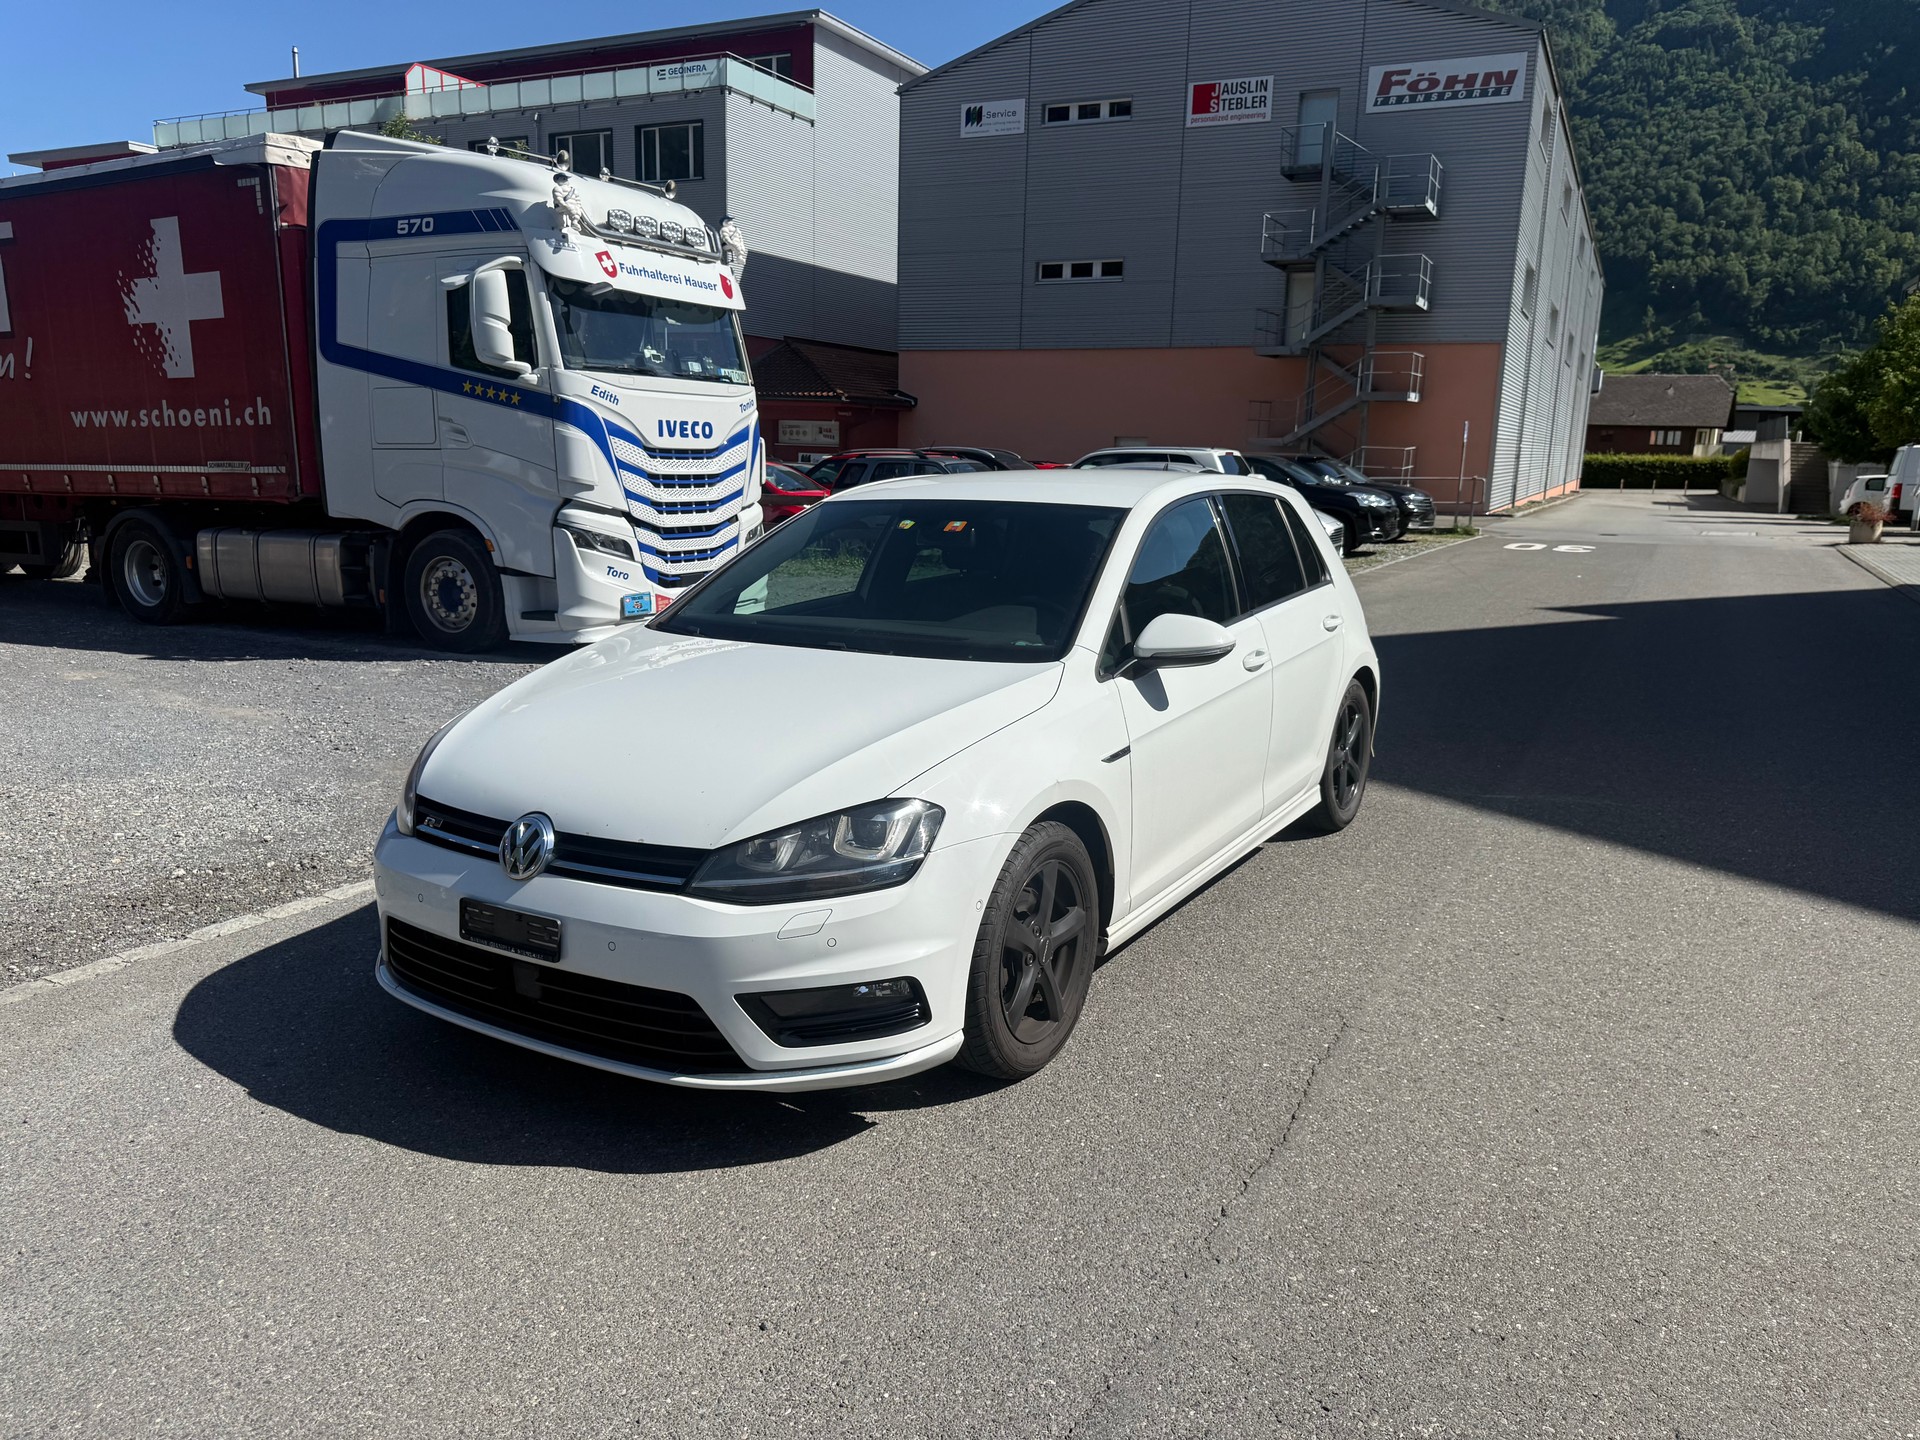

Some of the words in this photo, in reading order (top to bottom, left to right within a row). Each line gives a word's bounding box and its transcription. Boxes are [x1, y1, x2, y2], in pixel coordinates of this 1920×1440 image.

[668, 64, 707, 75] GEOINFRA
[1377, 68, 1518, 96] FÖHN
[1375, 87, 1509, 105] TRANSPORTE
[1190, 114, 1228, 124] personalized
[1230, 112, 1266, 122] engineering
[397, 217, 434, 234] 570
[619, 262, 683, 285] Fuhrhalterei
[684, 276, 718, 291] Hauser
[590, 384, 620, 406] Edith
[70, 397, 272, 427] www.schoeni.ch
[657, 419, 714, 439] IVECO
[606, 565, 629, 580] Toro
